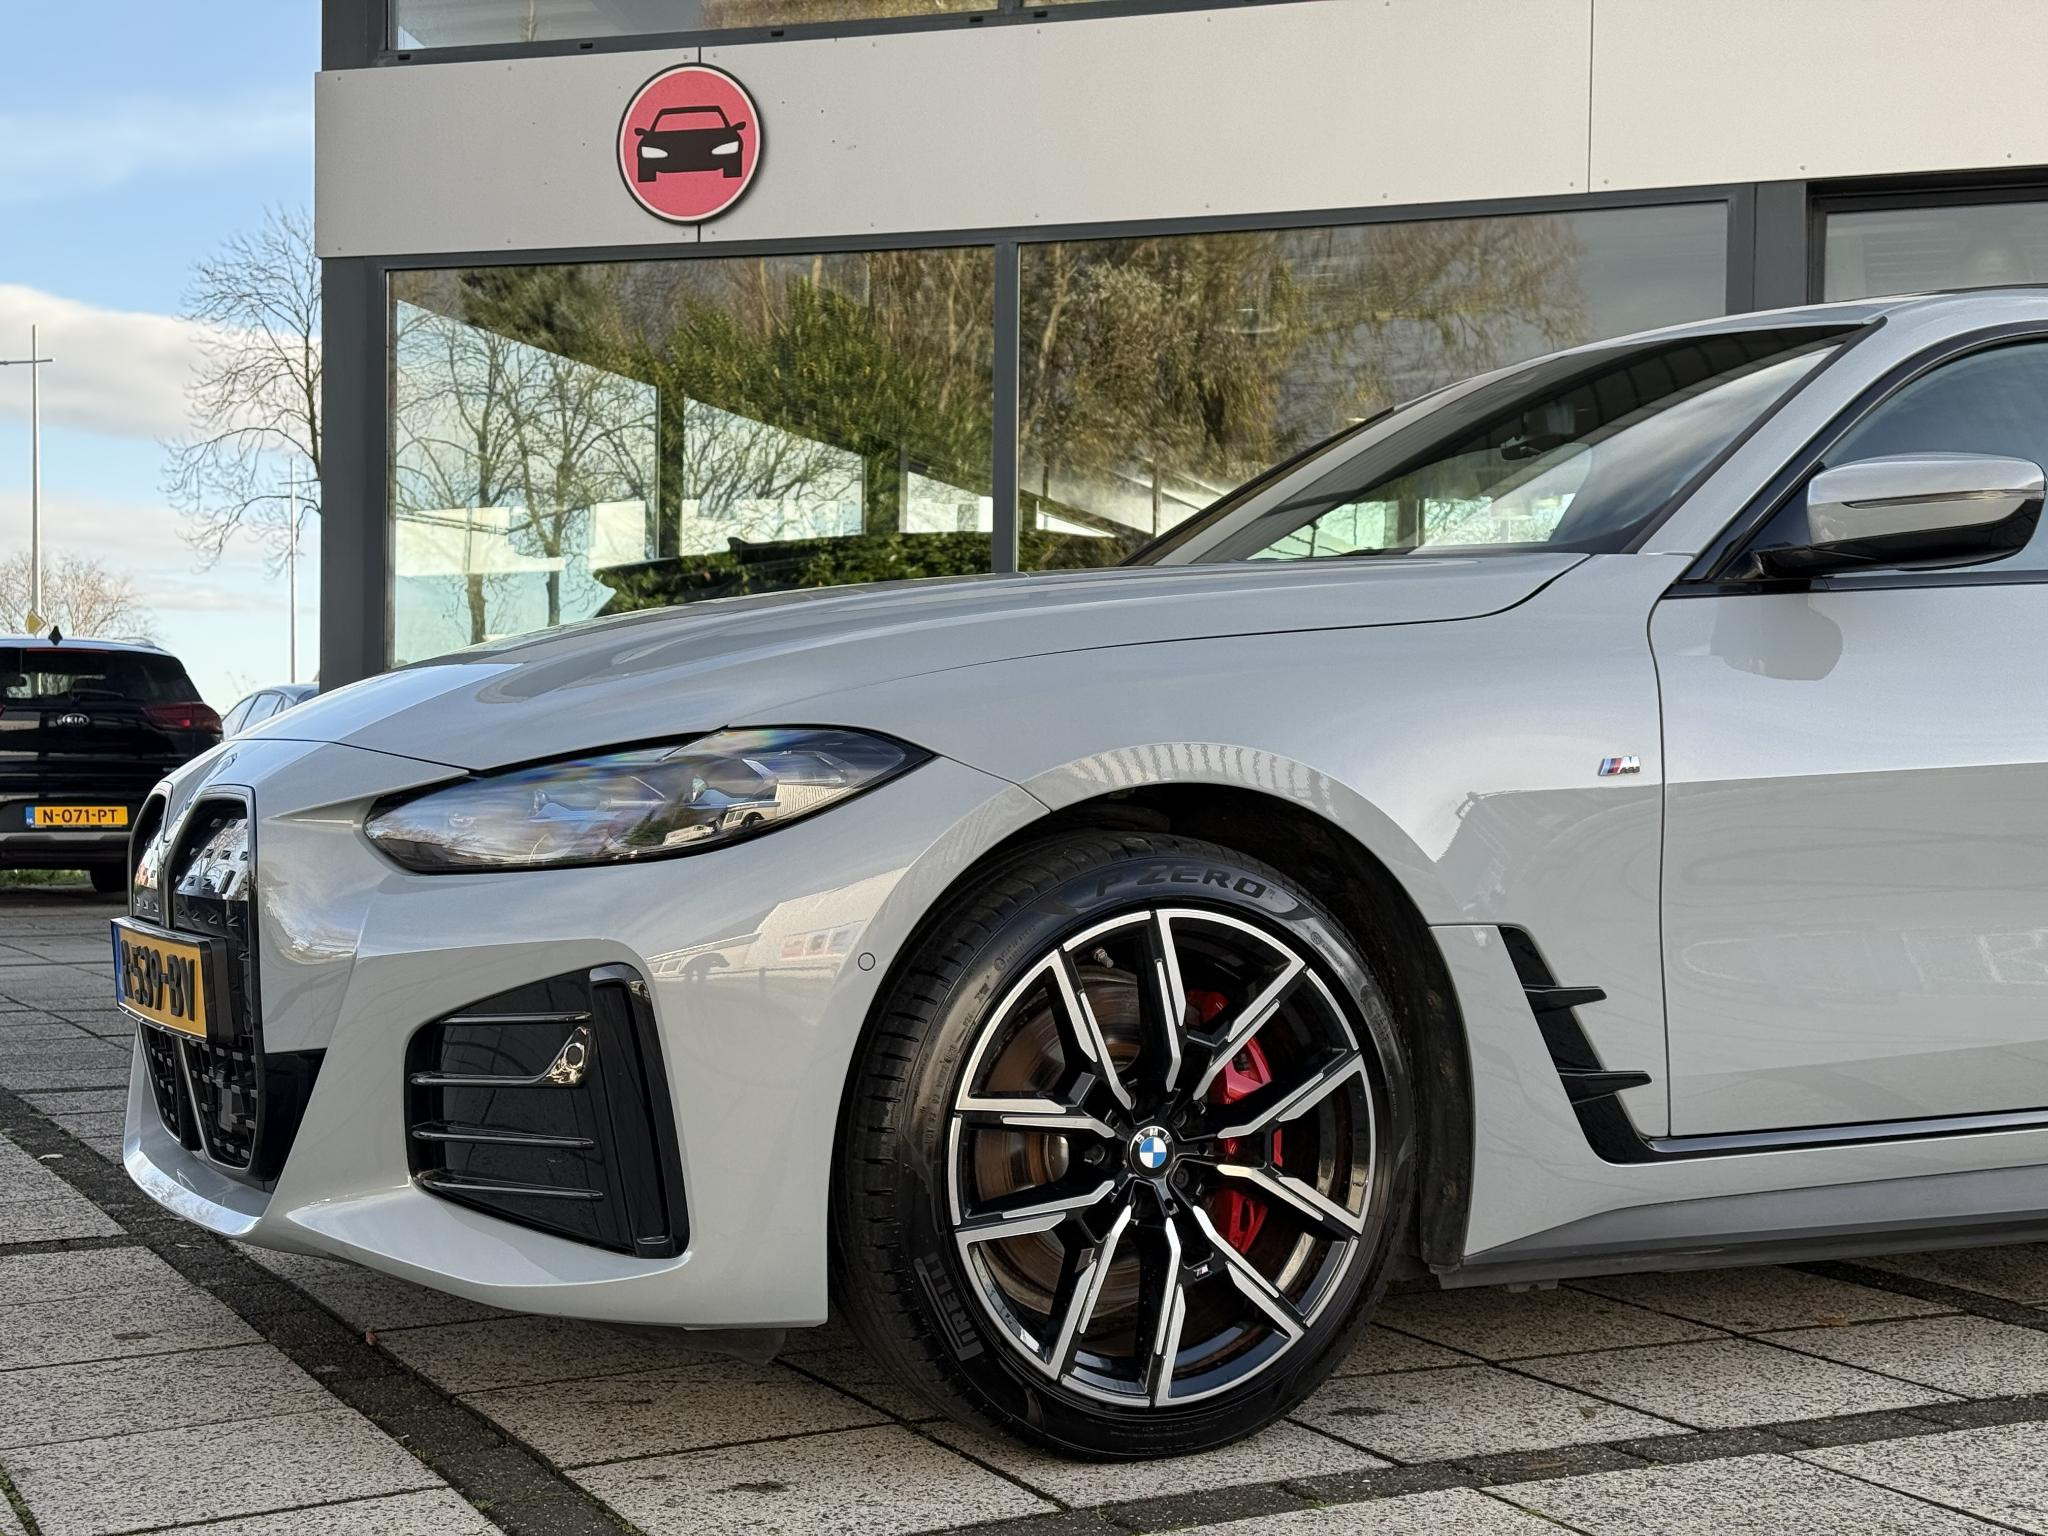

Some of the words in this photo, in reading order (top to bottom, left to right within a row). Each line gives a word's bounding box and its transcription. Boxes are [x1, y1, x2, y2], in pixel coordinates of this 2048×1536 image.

[42, 809, 118, 824] N-071-PT
[1136, 864, 1267, 899] ZERO
[1135, 1127, 1172, 1144] BMW
[913, 1252, 985, 1362] PIRELLI
